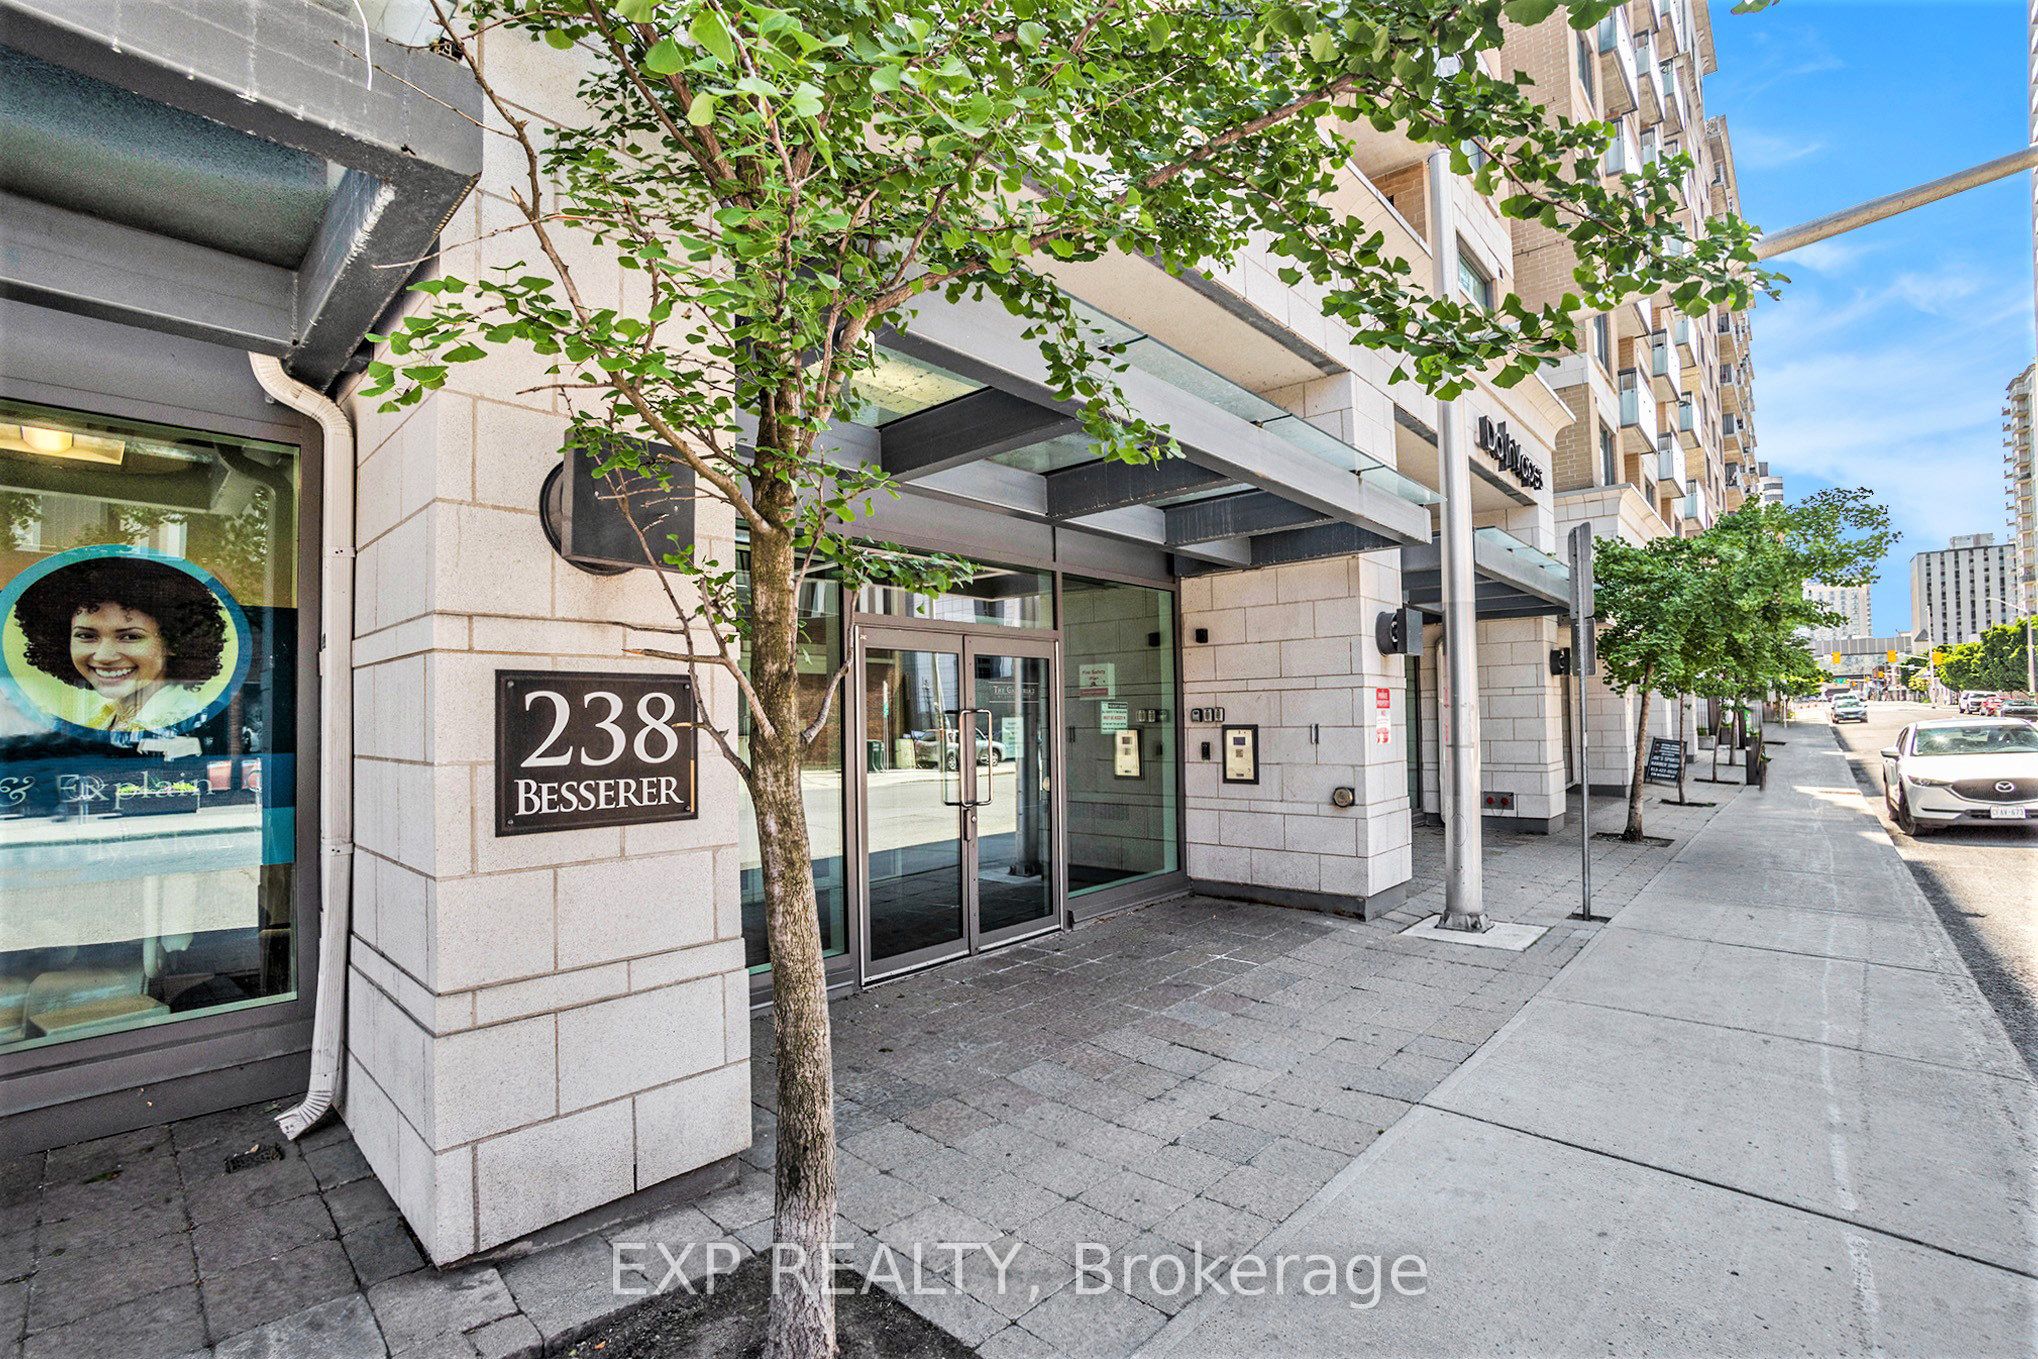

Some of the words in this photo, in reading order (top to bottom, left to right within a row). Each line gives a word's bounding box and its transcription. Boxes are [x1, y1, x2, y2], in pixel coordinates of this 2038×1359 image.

[520, 690, 679, 768] 238
[56, 770, 215, 810] Explain
[514, 776, 685, 816] BESSERER
